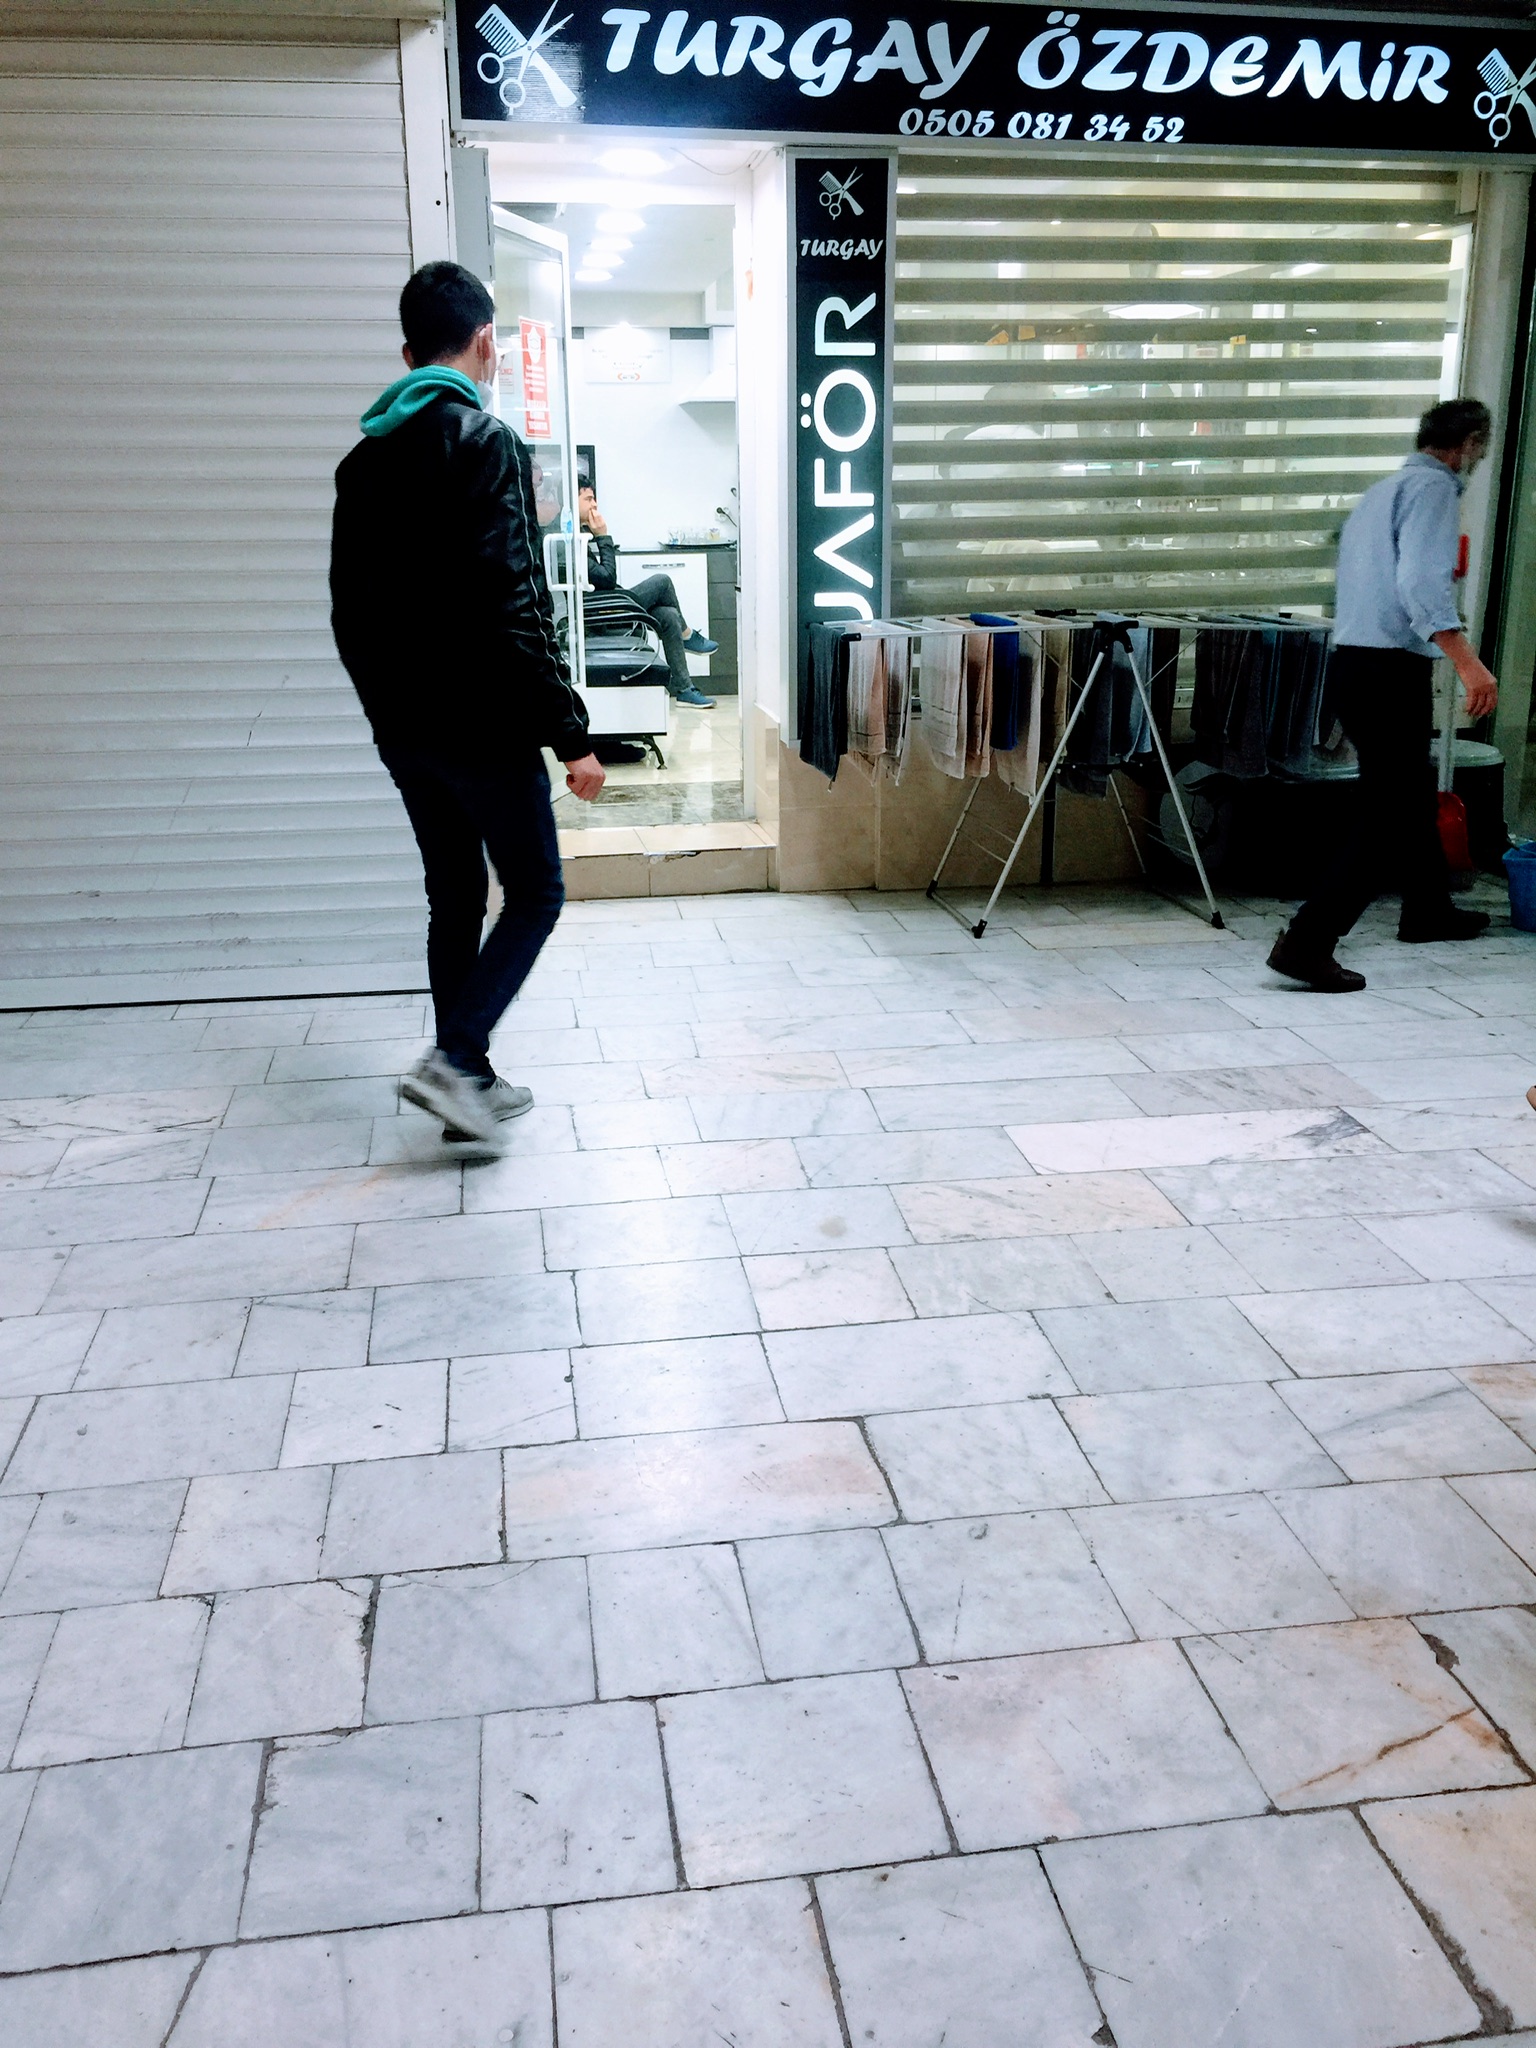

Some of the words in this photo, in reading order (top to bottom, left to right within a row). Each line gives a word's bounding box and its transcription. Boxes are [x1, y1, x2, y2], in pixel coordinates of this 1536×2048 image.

[601, 8, 990, 100] TURGAY
[899, 108, 995, 137] 0505
[1007, 111, 1073, 141] 081
[1083, 113, 1131, 142] 34
[1142, 116, 1185, 144] 52
[800, 238, 884, 261] TURGAY
